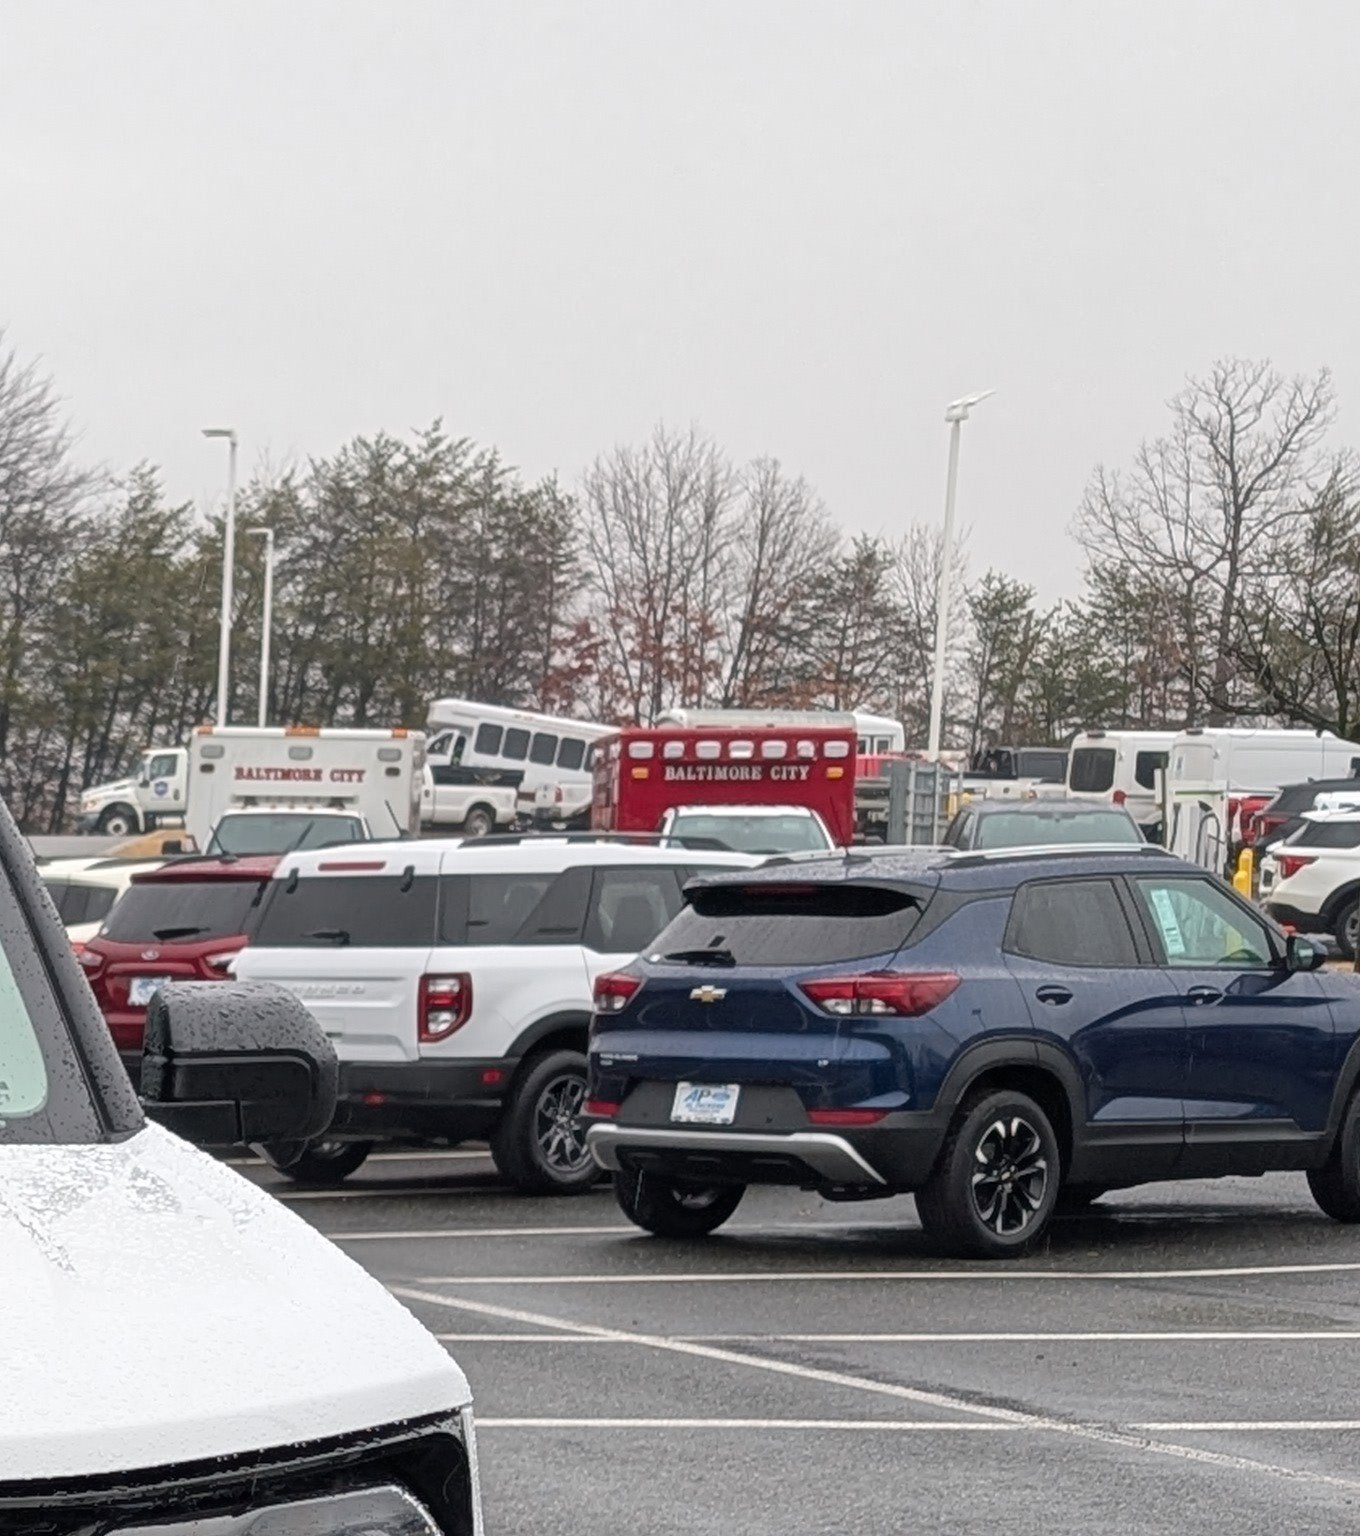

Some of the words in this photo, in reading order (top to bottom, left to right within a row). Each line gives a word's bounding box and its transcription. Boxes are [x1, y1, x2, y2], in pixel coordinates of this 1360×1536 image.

[234, 766, 323, 782] BALTIMORE
[329, 768, 366, 783] CITY
[664, 765, 762, 781] BALTIMORE
[769, 765, 810, 781] CITY
